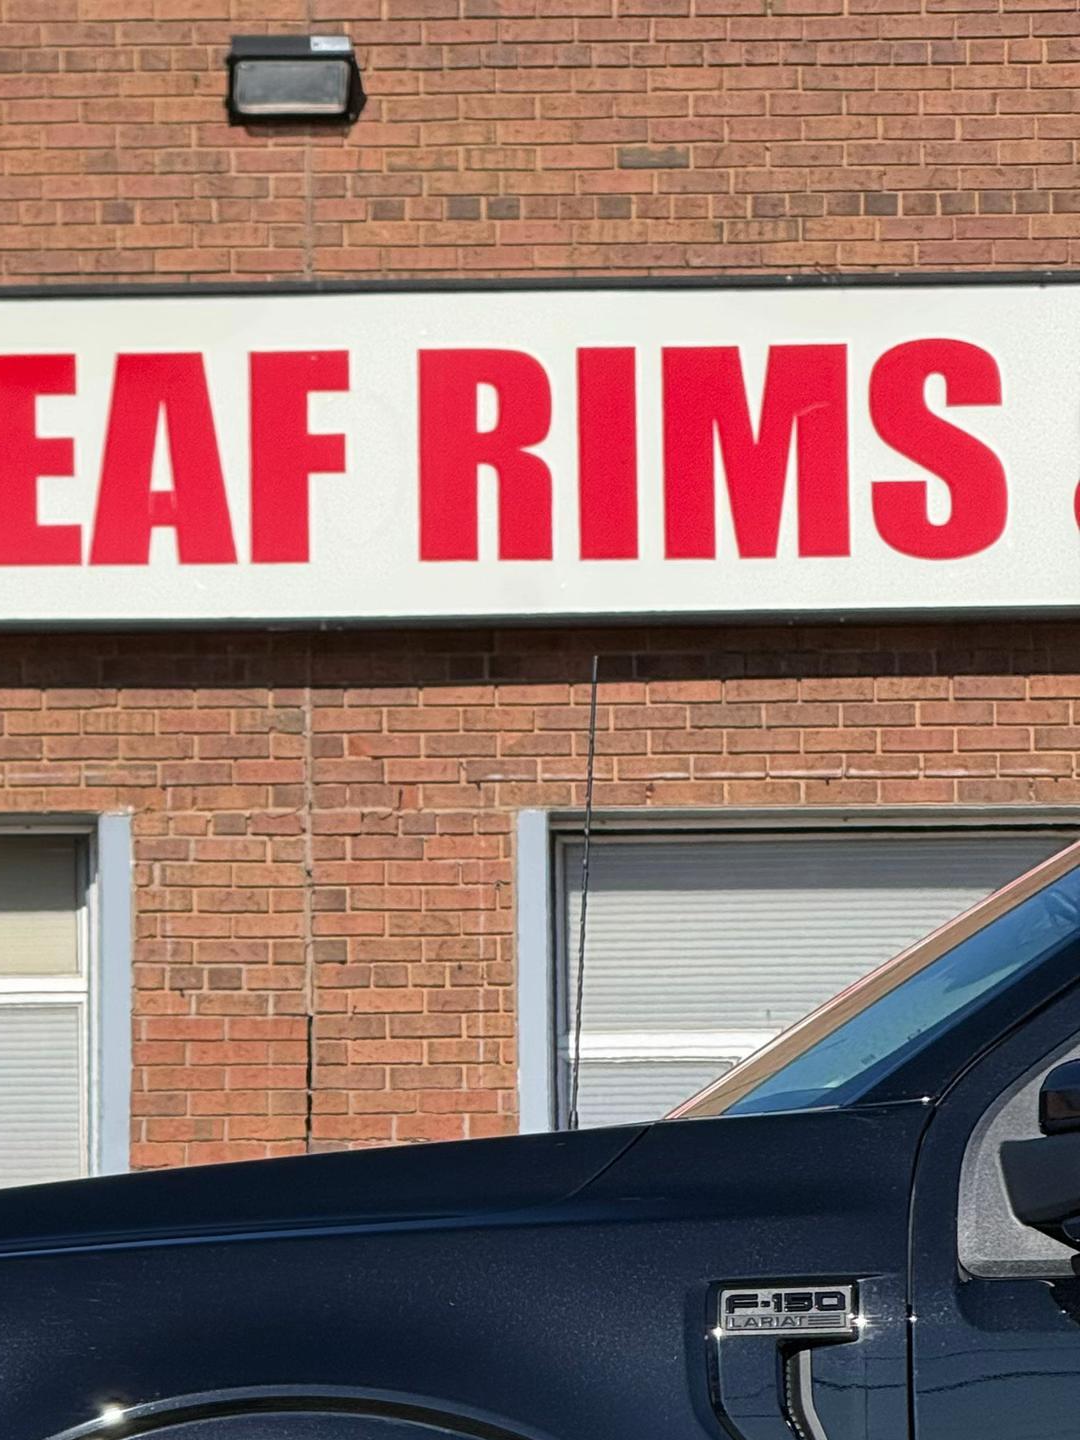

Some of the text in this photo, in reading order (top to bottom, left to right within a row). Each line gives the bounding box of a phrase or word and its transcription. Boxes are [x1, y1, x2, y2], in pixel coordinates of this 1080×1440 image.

[418, 337, 1009, 562] RIMS
[725, 1291, 846, 1314] F-150
[729, 1315, 808, 1328] LARIAT
